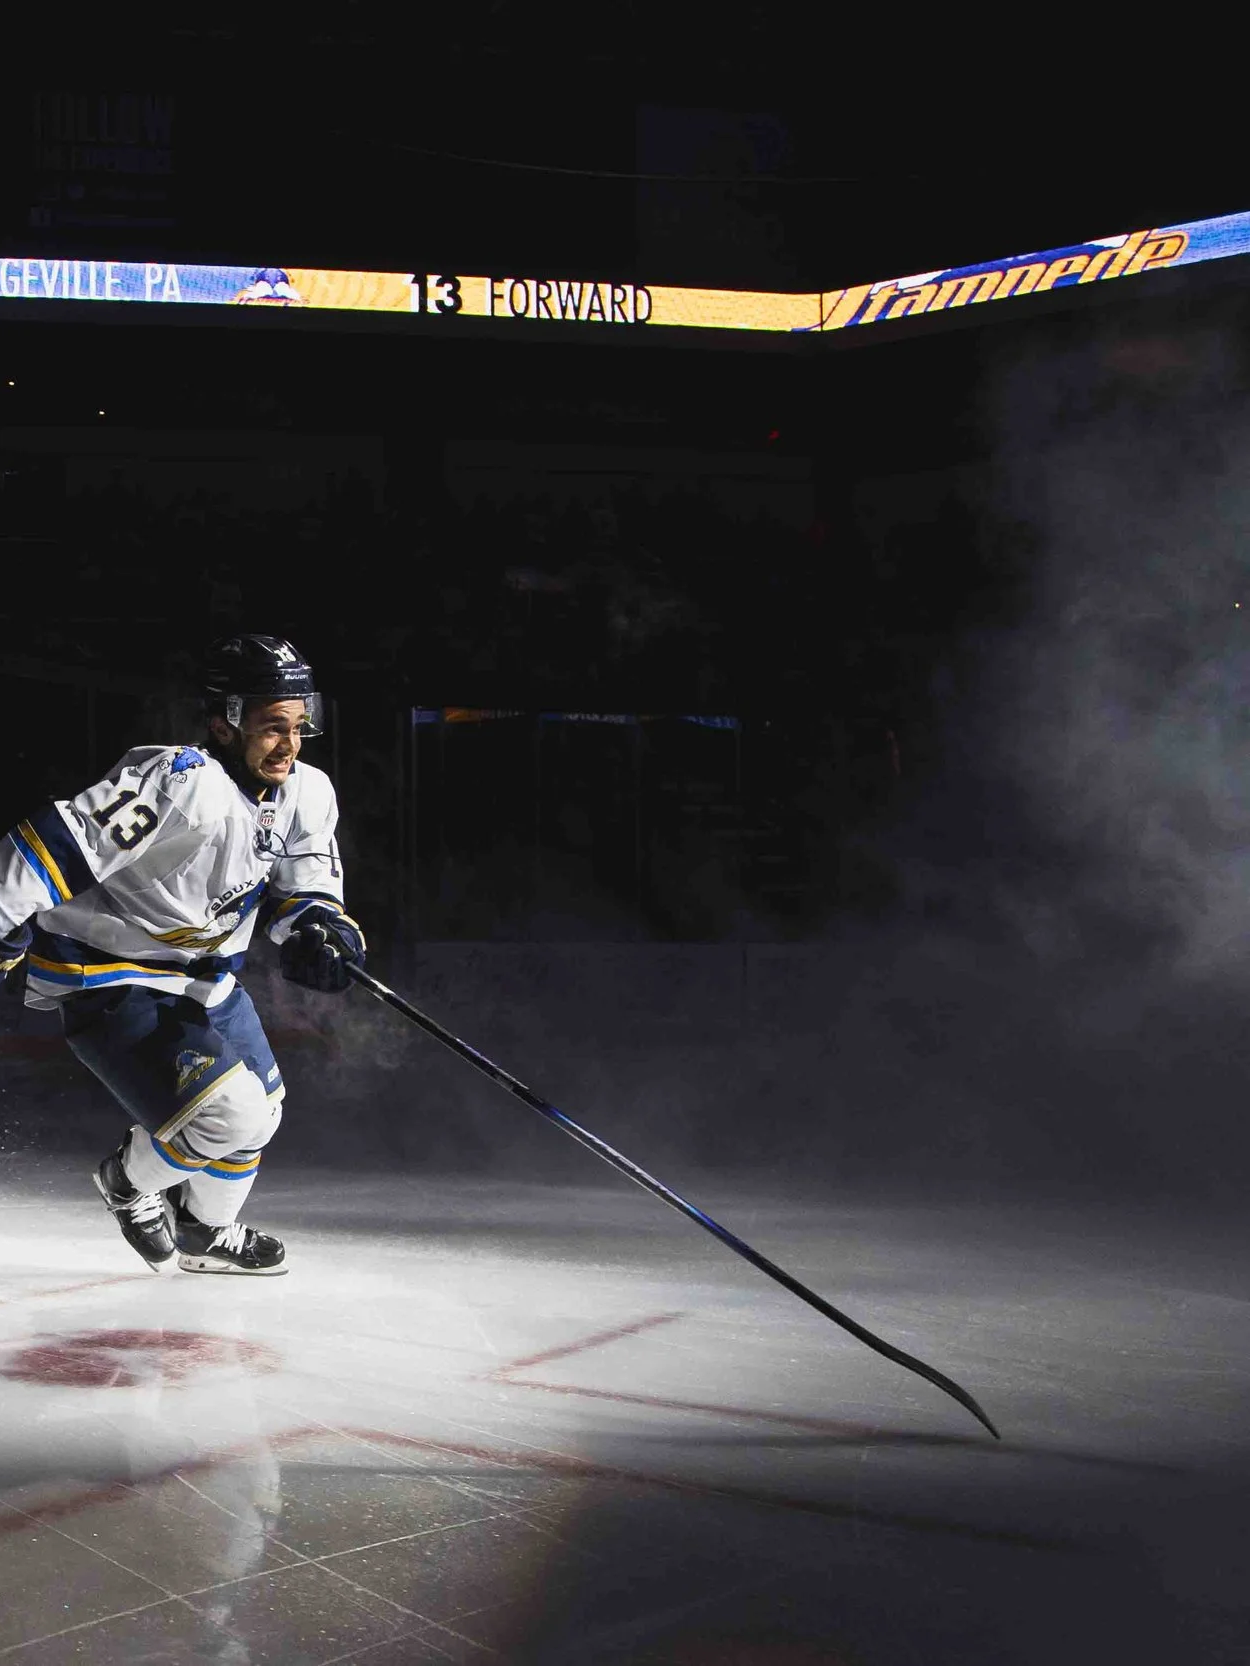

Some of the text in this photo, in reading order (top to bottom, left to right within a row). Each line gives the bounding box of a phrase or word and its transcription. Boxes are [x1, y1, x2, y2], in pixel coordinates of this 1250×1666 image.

[145, 263, 182, 302] PA
[406, 274, 652, 324] 13 FORWARD
[91, 789, 159, 852] 13
[210, 879, 256, 912] SIOUX
